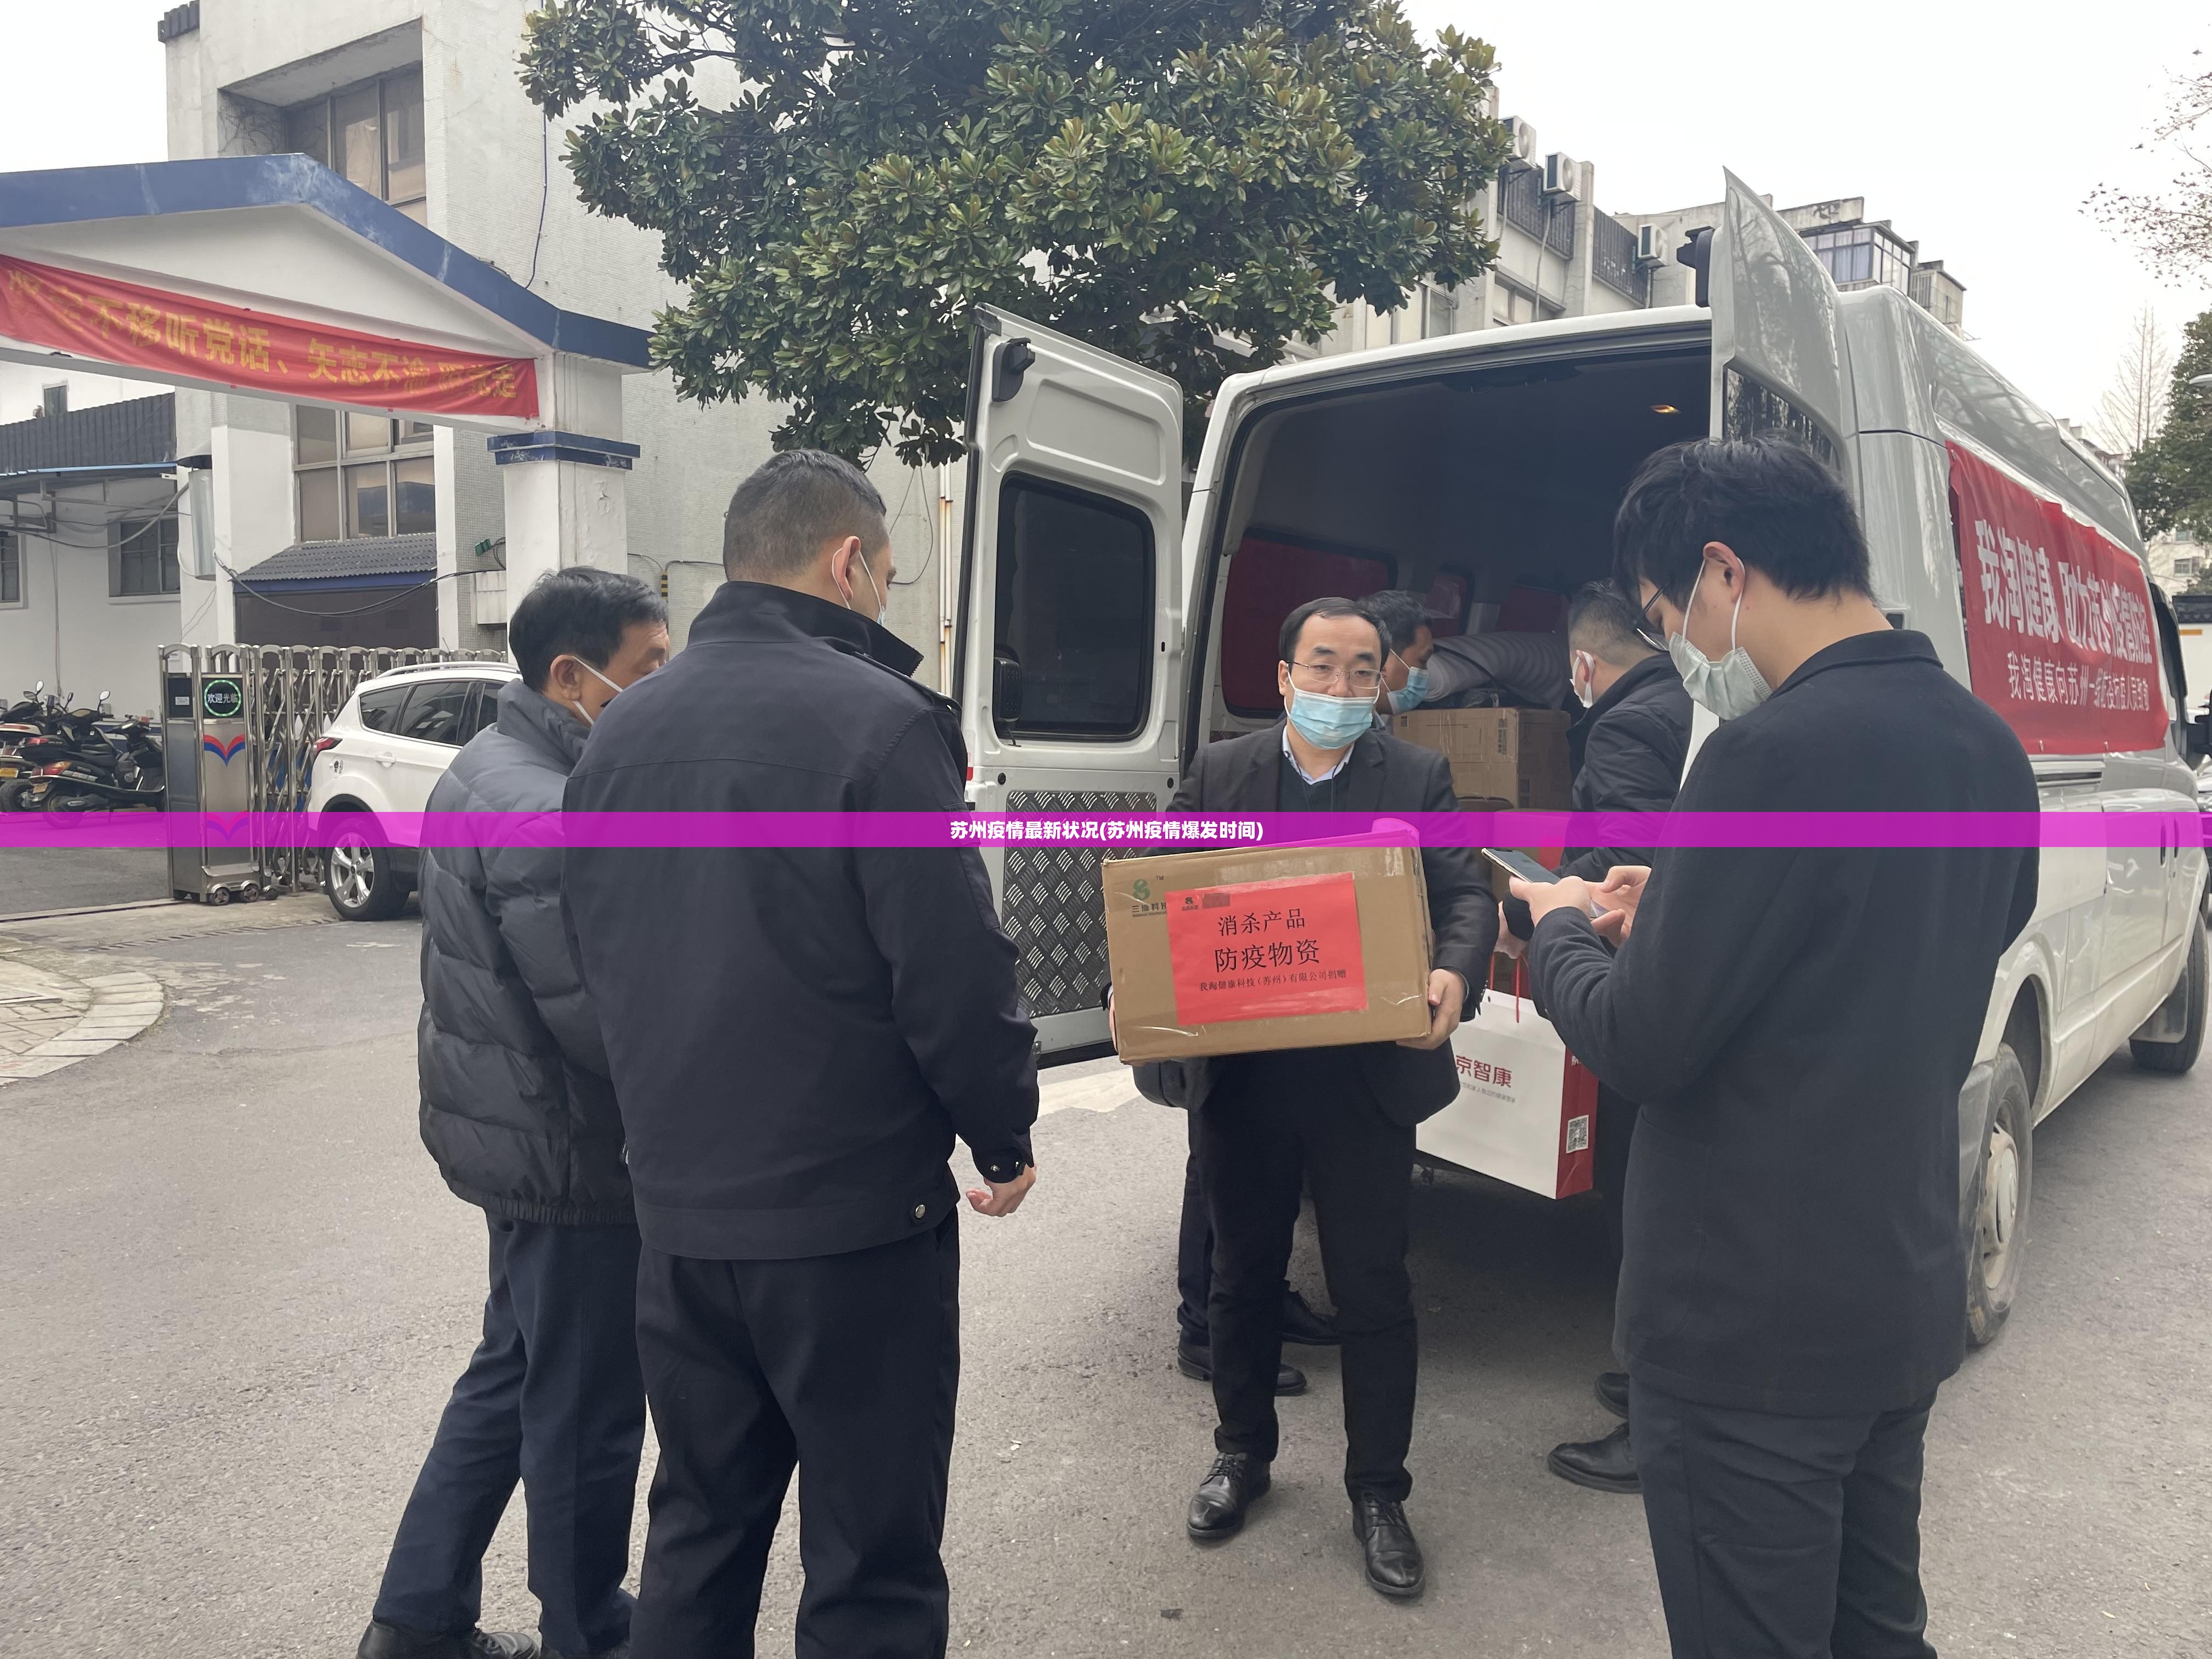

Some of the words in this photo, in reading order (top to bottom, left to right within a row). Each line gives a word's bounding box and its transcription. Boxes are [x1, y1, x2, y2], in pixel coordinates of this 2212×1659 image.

[207, 693, 238, 704] 欢迎光临
[1217, 908, 1306, 936] 消杀产品
[1215, 939, 1321, 973] 防疫物资
